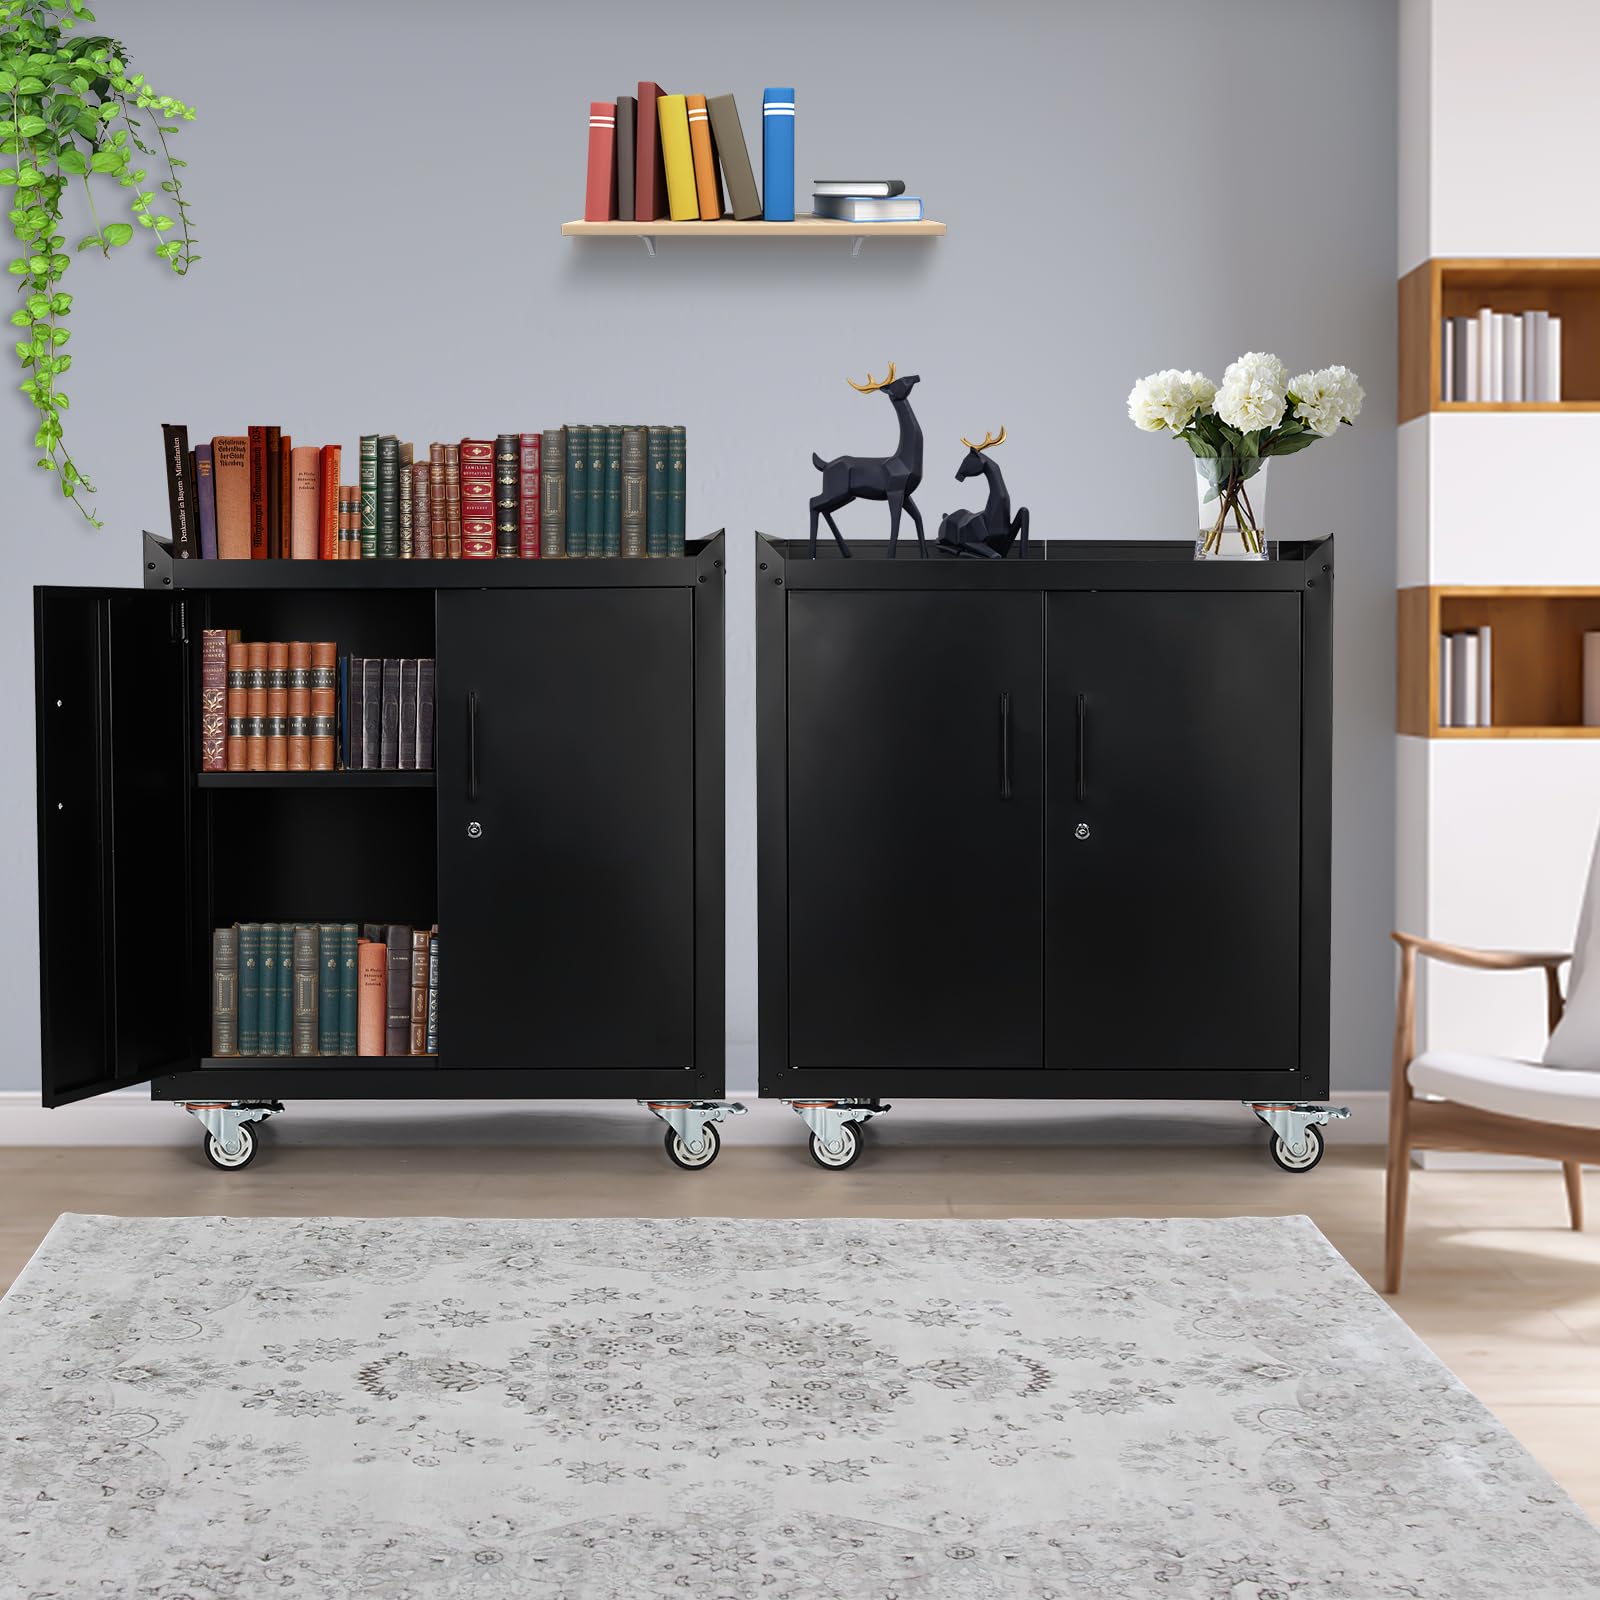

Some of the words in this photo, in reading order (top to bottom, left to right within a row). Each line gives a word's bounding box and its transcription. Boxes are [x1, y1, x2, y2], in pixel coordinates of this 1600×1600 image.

[175, 437, 183, 477] Mittelfranken
[178, 480, 186, 501] Bayern
[180, 509, 188, 543] Denkmäler
